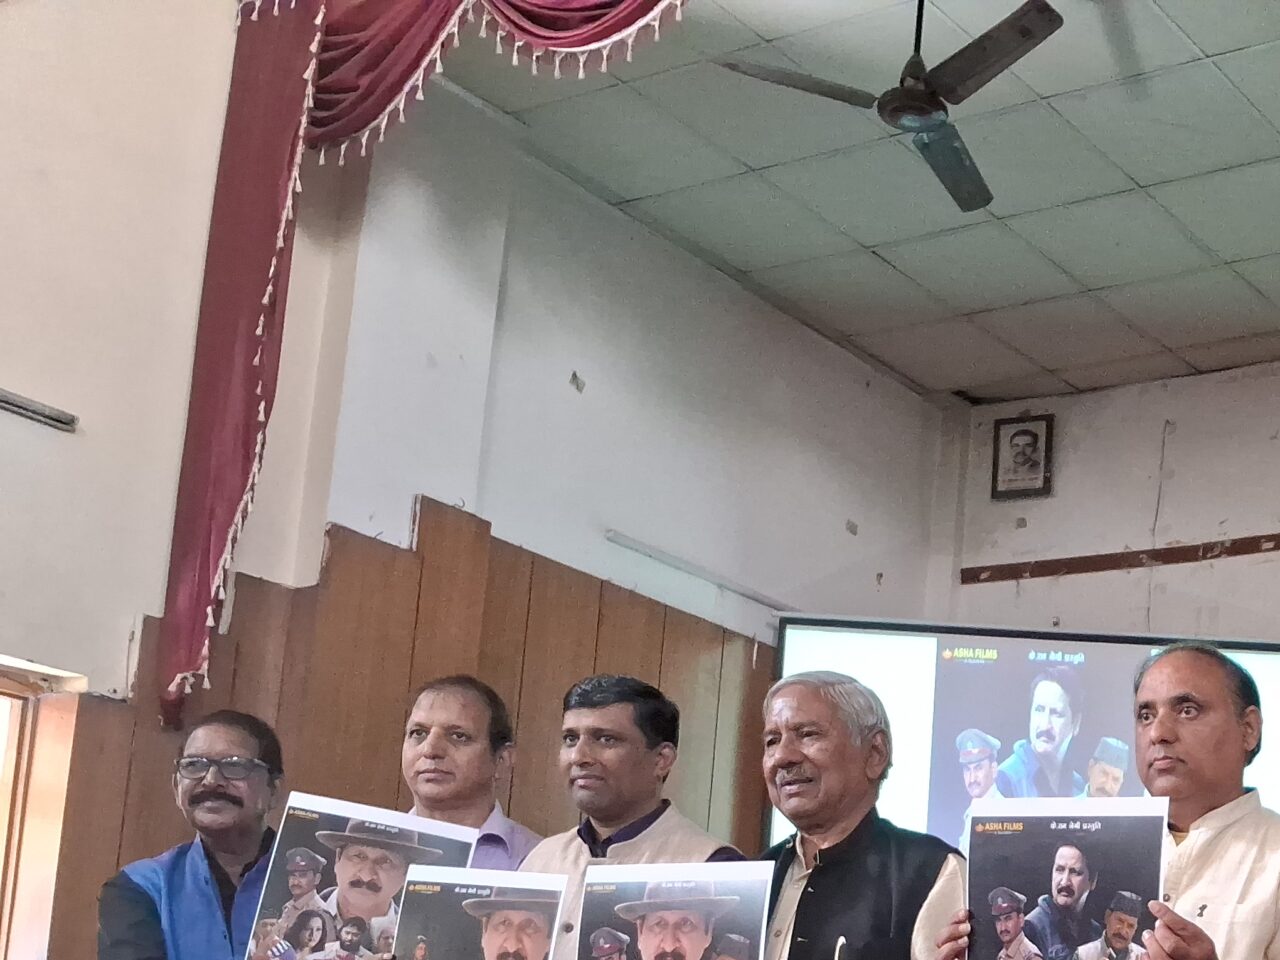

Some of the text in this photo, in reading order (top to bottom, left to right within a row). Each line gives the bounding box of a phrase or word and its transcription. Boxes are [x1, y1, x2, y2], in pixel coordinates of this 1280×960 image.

[974, 649, 998, 660] FILMS
[984, 822, 1024, 831] ASHA FILMS
